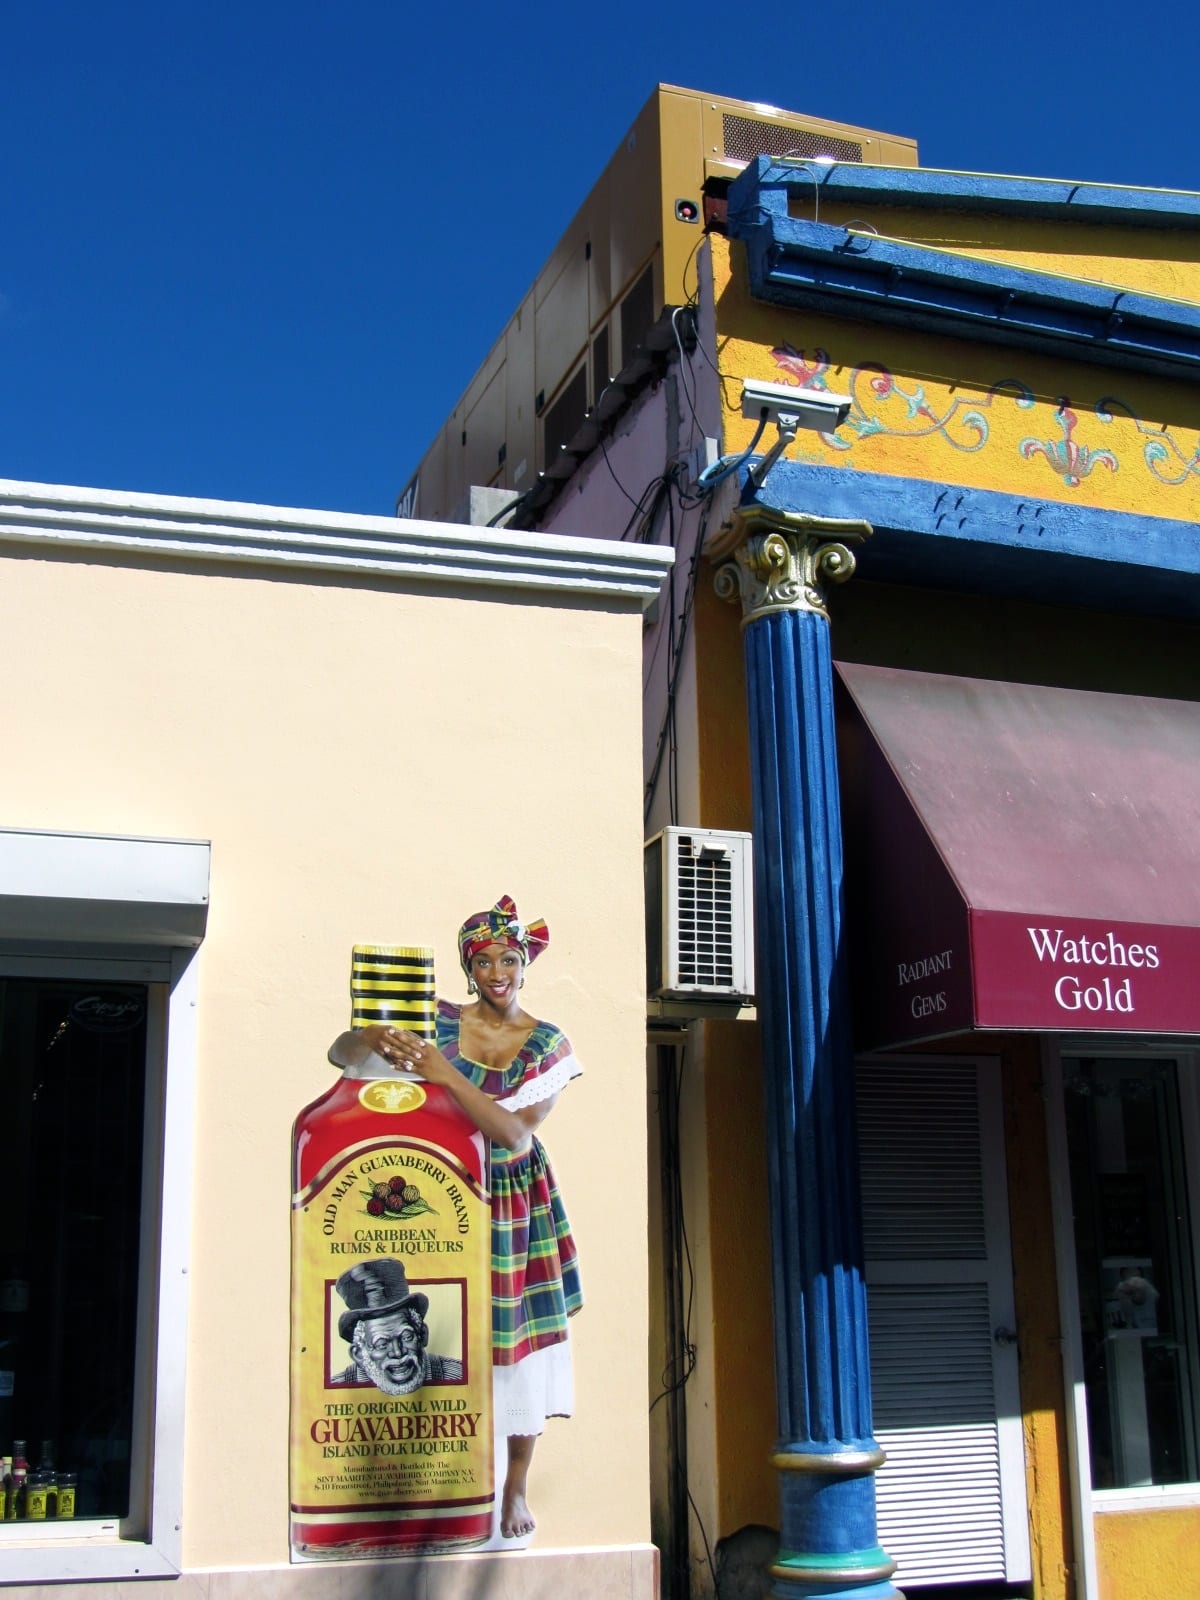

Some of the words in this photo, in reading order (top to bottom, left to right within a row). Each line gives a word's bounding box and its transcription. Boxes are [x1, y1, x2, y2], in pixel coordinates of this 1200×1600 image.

[1027, 927, 1160, 968] Watches
[897, 950, 952, 986] RADIANT
[911, 991, 947, 1019] GEMS
[1054, 976, 1135, 1012] Gold
[322, 1203, 338, 1236] OLD
[331, 1170, 360, 1202] MAN
[359, 1154, 450, 1185] GUAVABERRY
[445, 1184, 470, 1234] BRAND
[354, 1229, 437, 1241] CARIBBEAN
[331, 1241, 371, 1254] RUMS
[375, 1242, 387, 1254] &
[391, 1240, 464, 1255] LIQUEURS
[325, 1403, 354, 1416] THE
[357, 1401, 427, 1415] ORIGINAL
[430, 1399, 467, 1412] WILD
[310, 1413, 482, 1444] GUAVABERRY
[323, 1445, 370, 1458] ISLAND
[374, 1443, 408, 1456] FOLK
[411, 1440, 468, 1456] LIQUEUR
[317, 1475, 336, 1483] SINT
[424, 1469, 460, 1478] COMPANY
[437, 1461, 450, 1469] The
